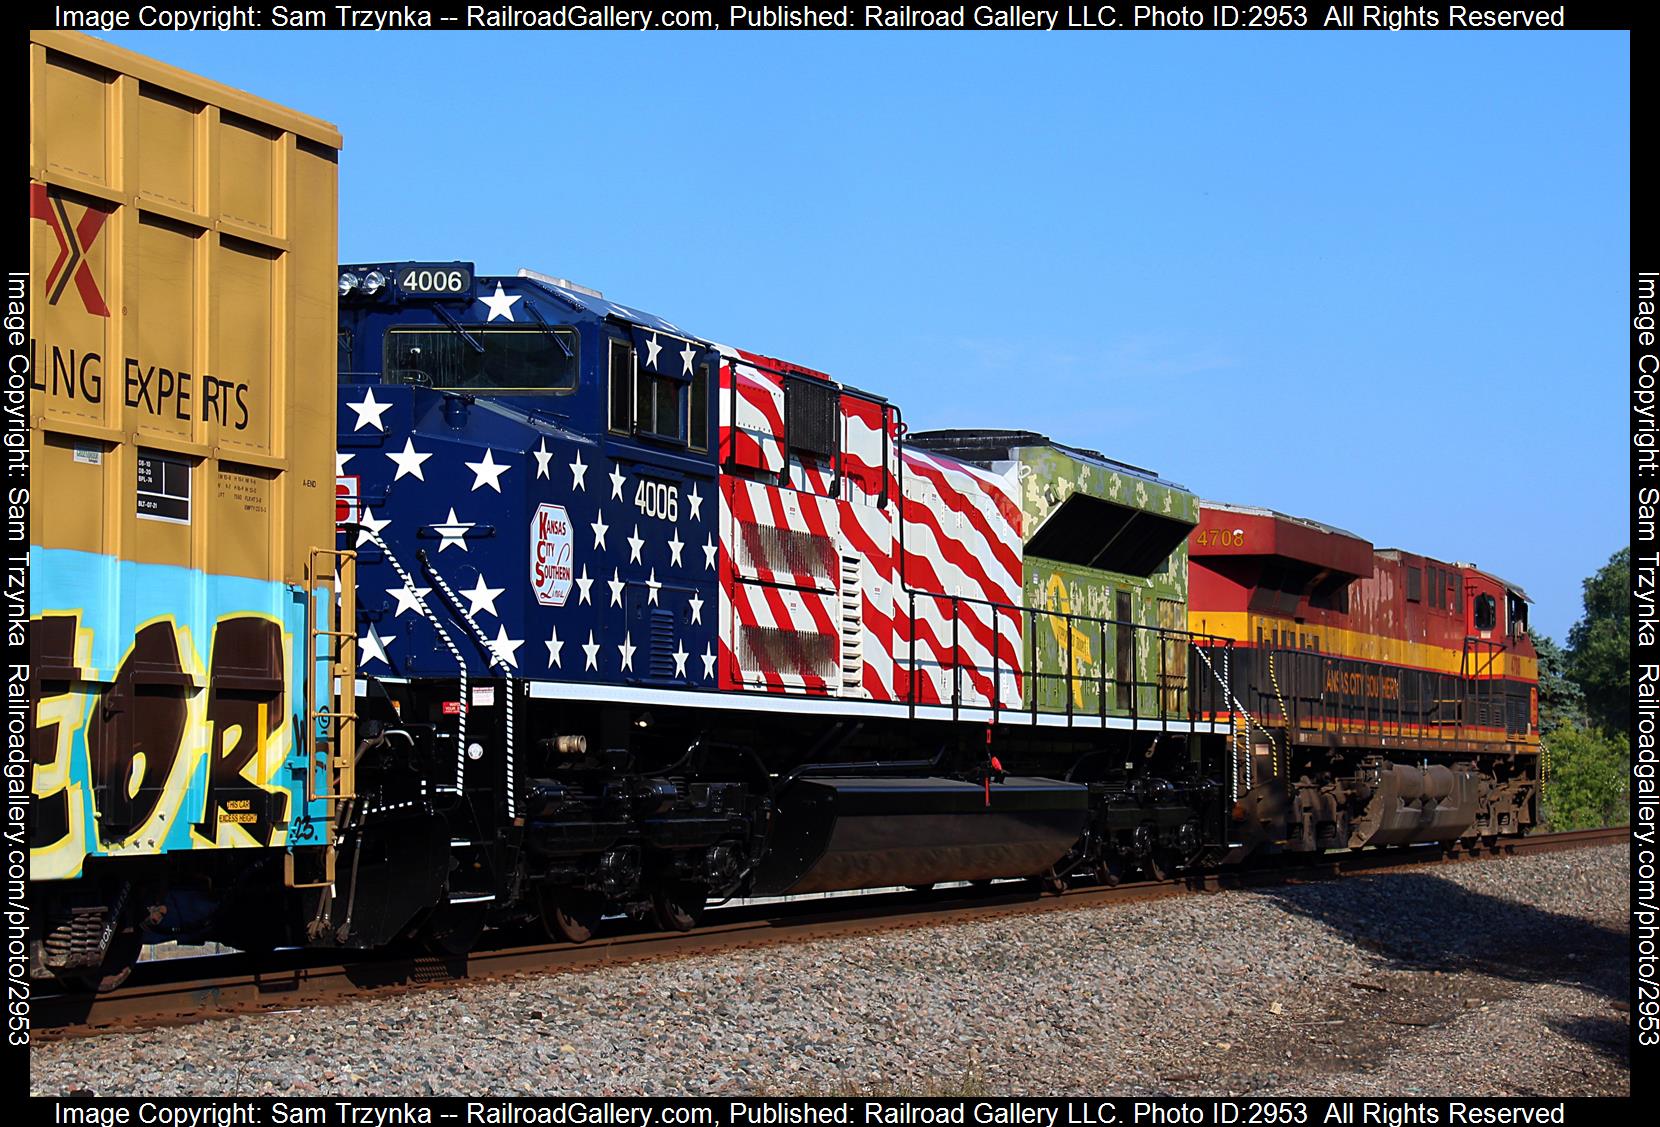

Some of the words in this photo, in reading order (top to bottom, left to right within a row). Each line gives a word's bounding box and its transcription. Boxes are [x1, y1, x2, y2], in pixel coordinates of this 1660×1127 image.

[403, 271, 462, 292] 4006
[125, 358, 249, 430] EXPERTS
[302, 479, 317, 488] A-END
[634, 480, 678, 522] 4006
[539, 511, 566, 540] KANSAS
[1196, 529, 1244, 547] 4708
[537, 540, 555, 564] CITY
[536, 561, 571, 587] SOUTHERN
[524, 683, 529, 696] F
[219, 814, 238, 823] EXCESS
